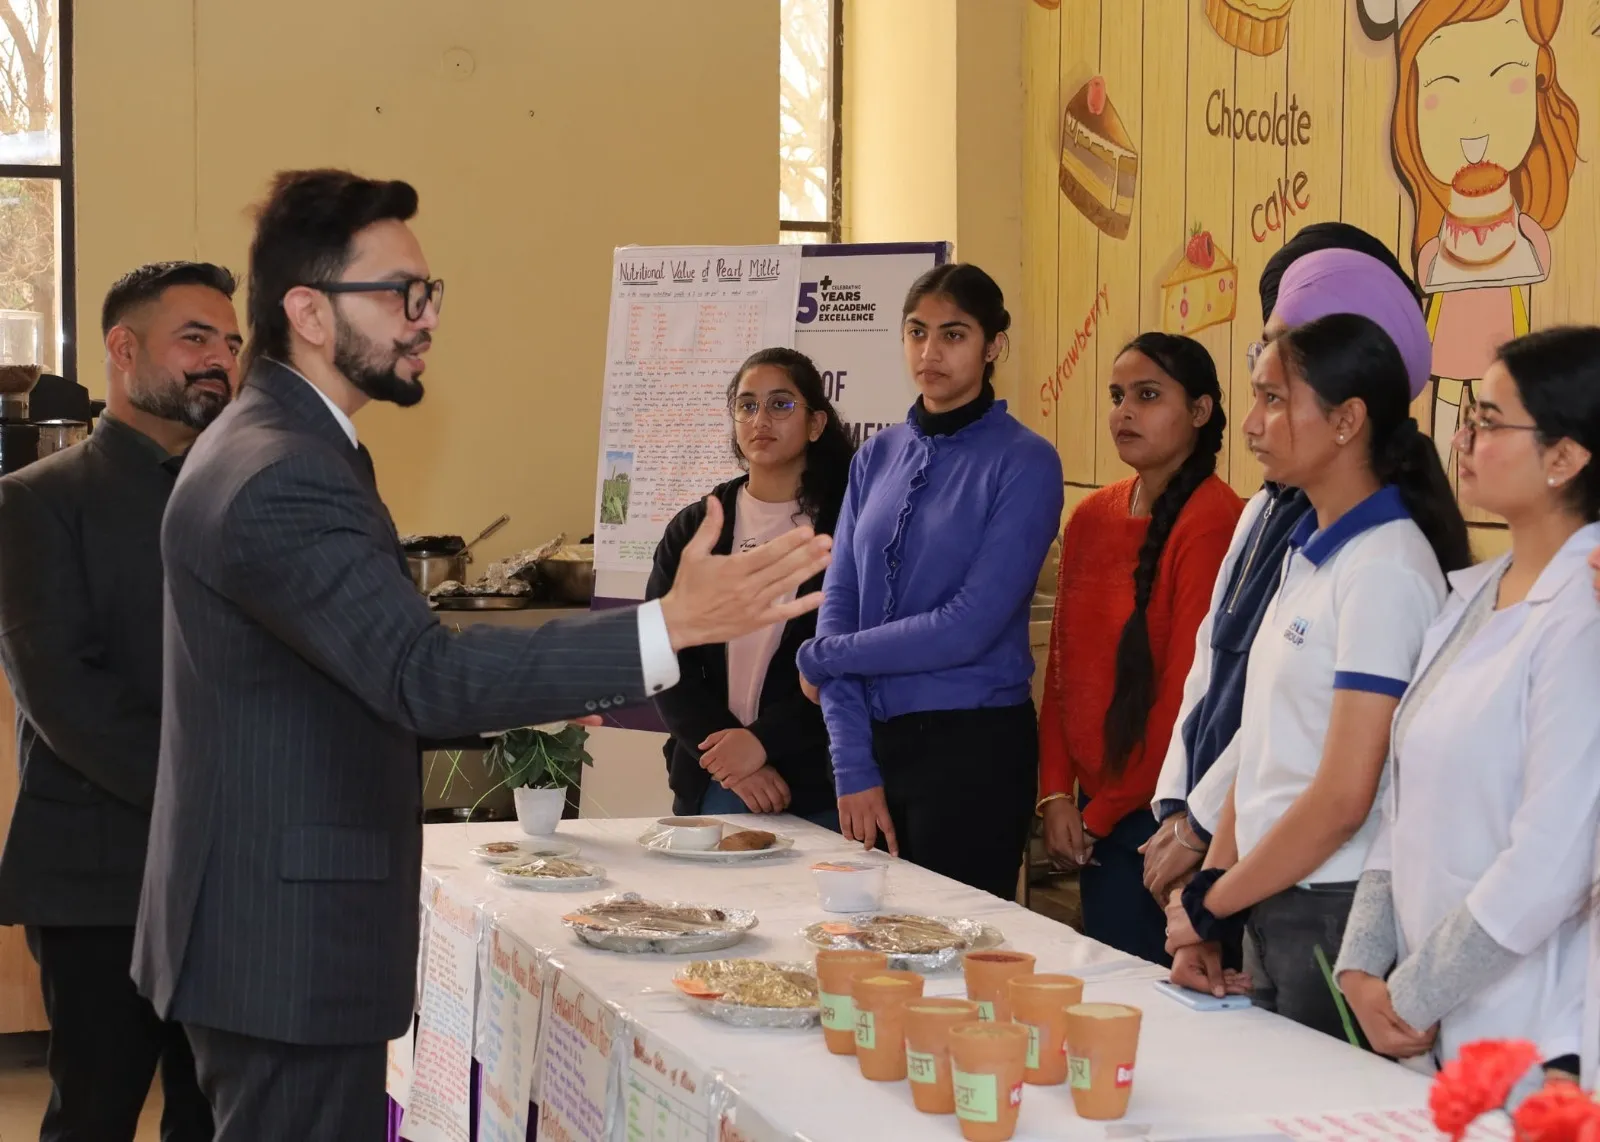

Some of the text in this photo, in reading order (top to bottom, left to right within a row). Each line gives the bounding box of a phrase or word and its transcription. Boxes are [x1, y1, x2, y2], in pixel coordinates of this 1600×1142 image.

[1206, 88, 1312, 147] Chocolate
[1251, 170, 1311, 243] cake
[619, 258, 781, 281] Nutritional Value of Pearl Millet
[819, 303, 876, 312] OF ACADEMIC
[821, 292, 861, 302] YEARS
[818, 313, 874, 322] EXCELLENCE
[1040, 283, 1110, 418] Strawberry
[821, 371, 847, 403] OF
